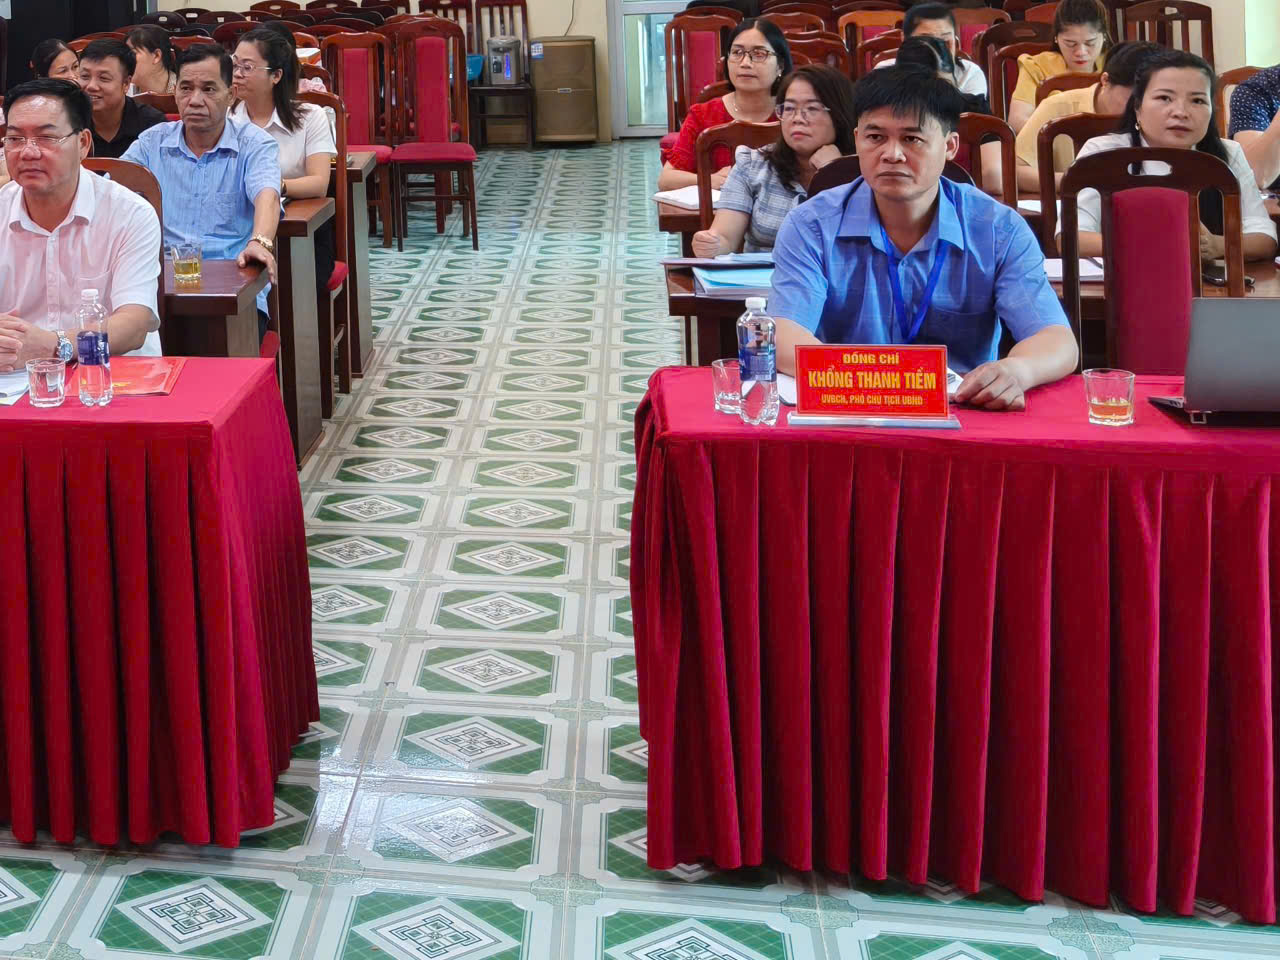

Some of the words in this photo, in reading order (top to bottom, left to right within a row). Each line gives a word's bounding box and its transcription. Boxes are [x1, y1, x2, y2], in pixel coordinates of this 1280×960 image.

[879, 352, 900, 364] CHÍ
[856, 371, 901, 389] THANH
[850, 393, 865, 404] PHÓ
